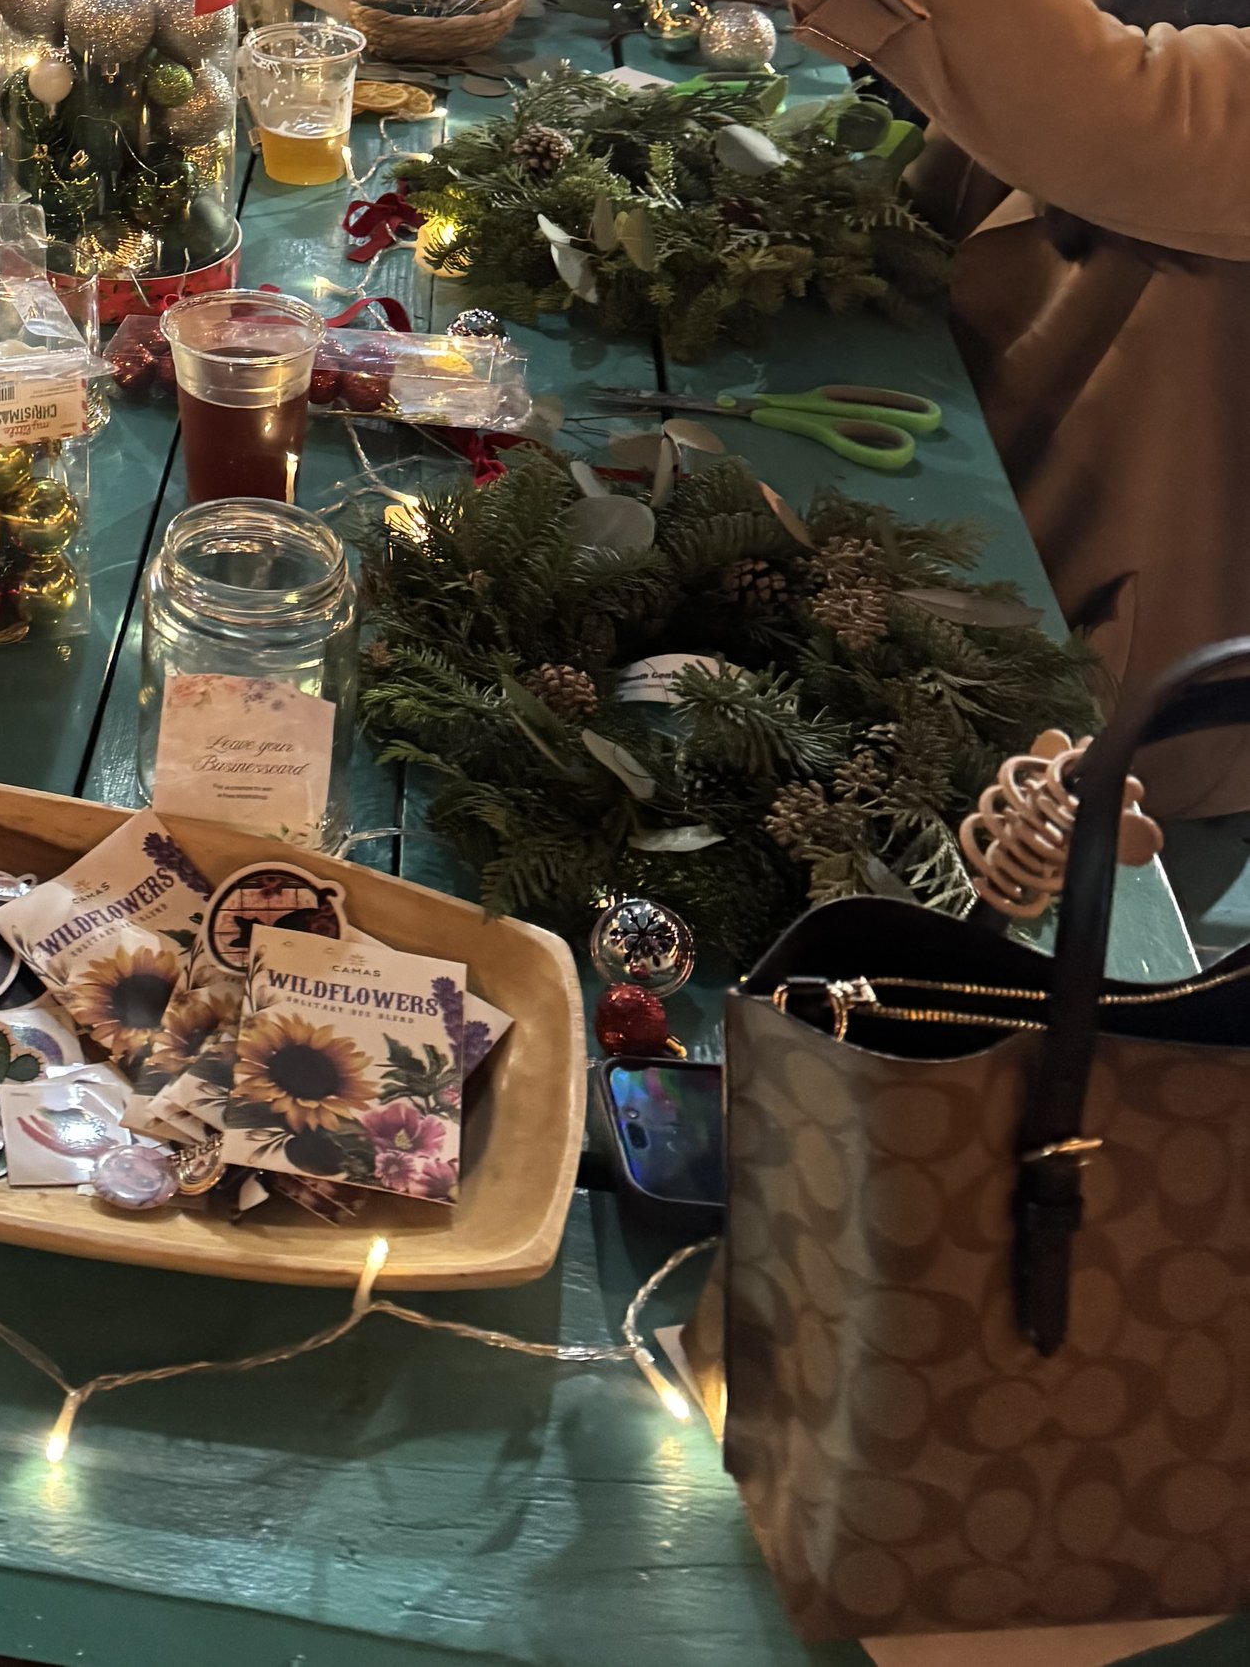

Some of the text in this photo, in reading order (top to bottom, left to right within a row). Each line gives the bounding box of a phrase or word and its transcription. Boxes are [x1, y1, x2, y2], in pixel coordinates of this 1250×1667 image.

[205, 735, 295, 757] Leave your
[72, 881, 110, 904] CAMAS
[36, 867, 175, 957] WILDFLOWERS
[331, 965, 382, 978] CAMAS
[267, 969, 440, 1016] WILDFLOWERS
